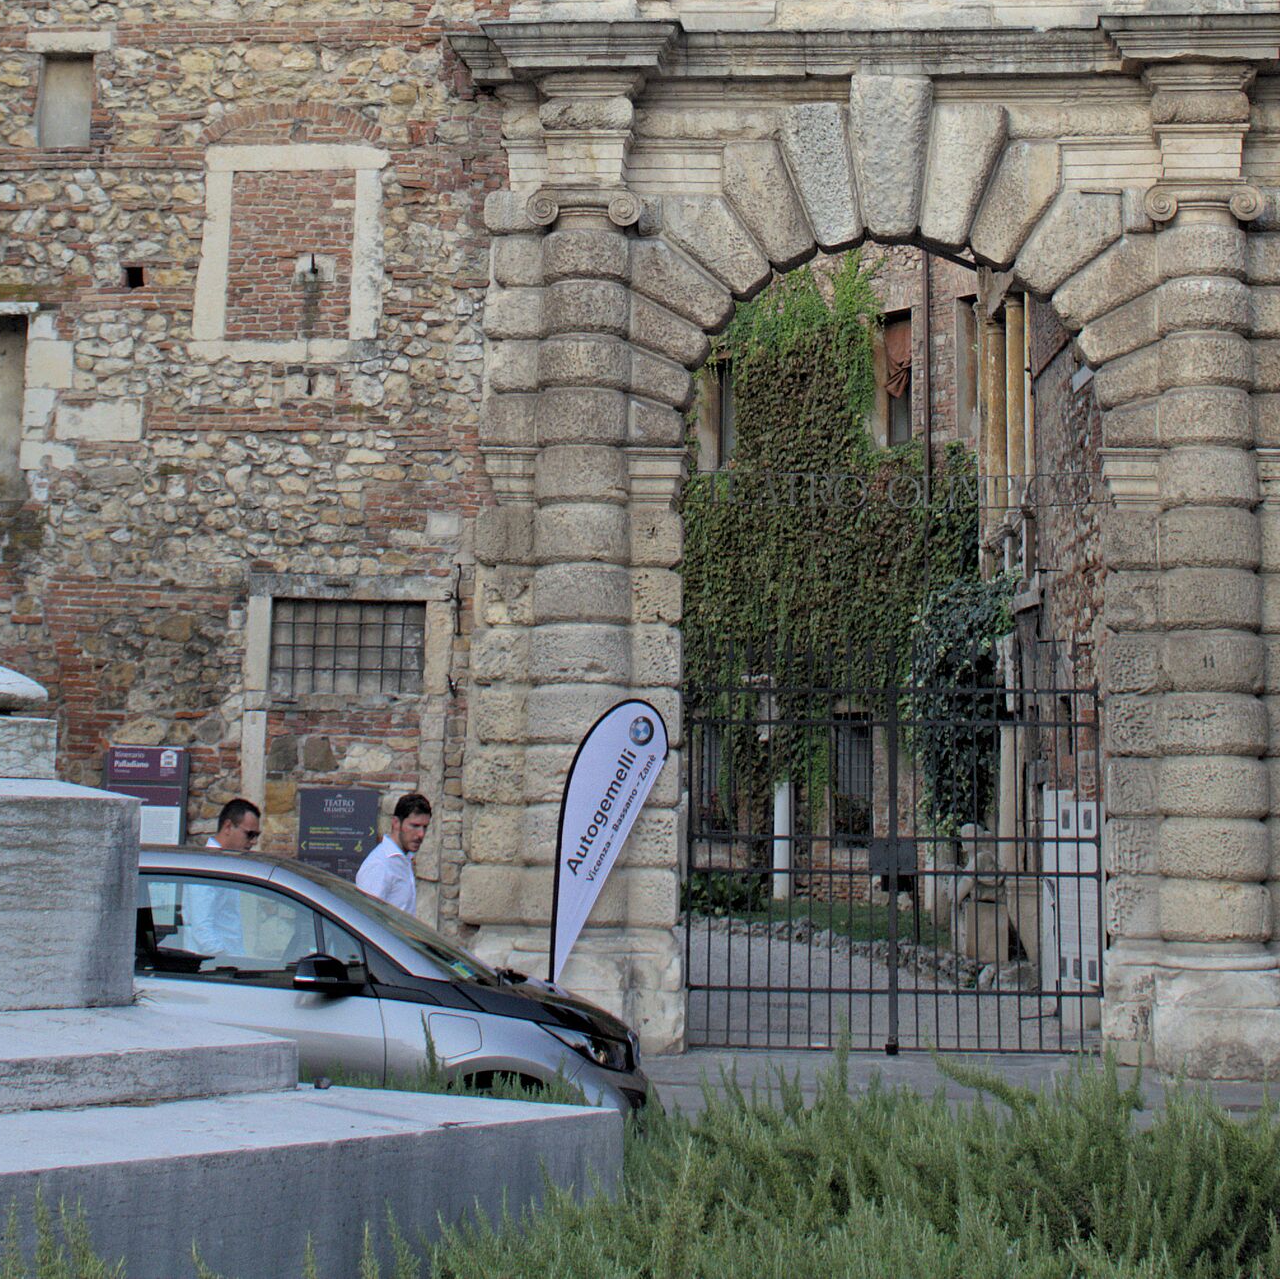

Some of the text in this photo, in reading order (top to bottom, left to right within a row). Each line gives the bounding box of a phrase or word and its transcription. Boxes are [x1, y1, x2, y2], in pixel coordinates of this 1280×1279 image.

[113, 760, 149, 768] Palladiano
[324, 799, 356, 807] TEATRO
[566, 747, 637, 876] Autogemelli
[586, 841, 612, 882] Vicenza
[612, 788, 638, 832] Bassano
[639, 754, 657, 781] Zanè
